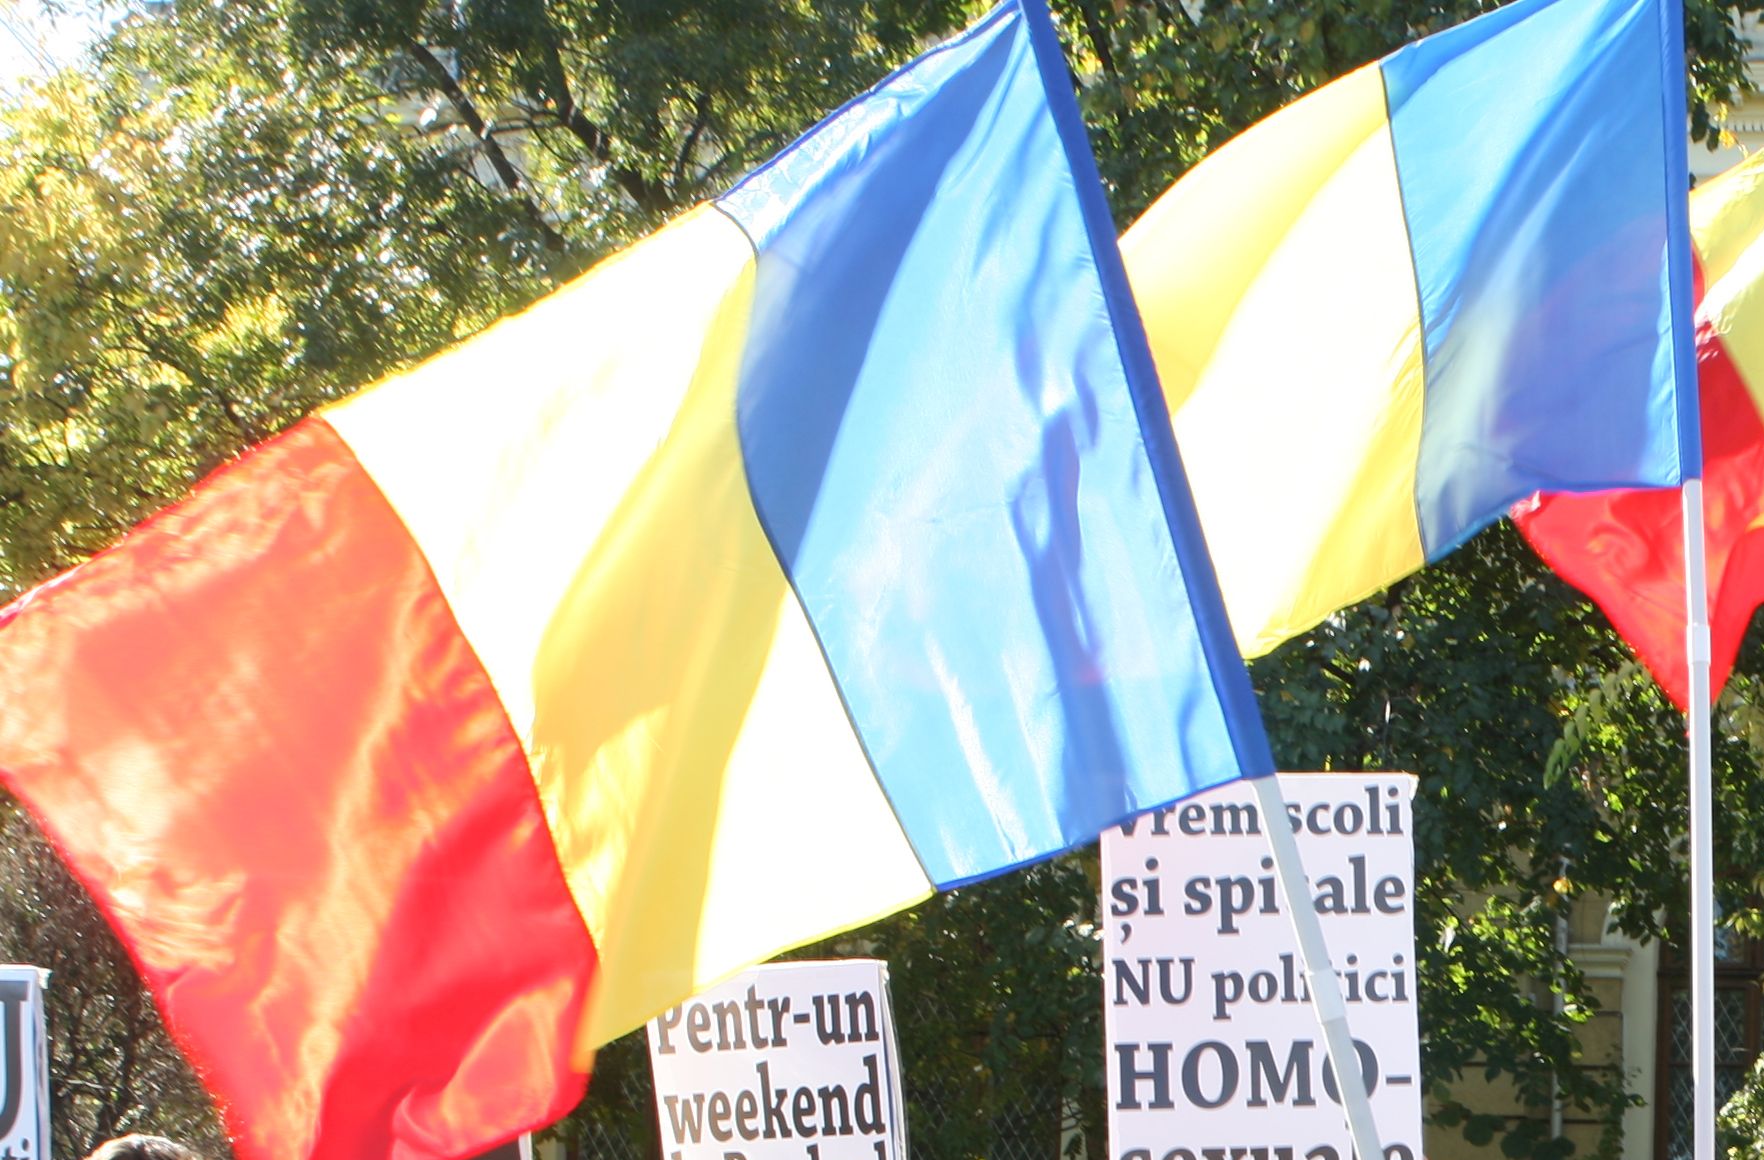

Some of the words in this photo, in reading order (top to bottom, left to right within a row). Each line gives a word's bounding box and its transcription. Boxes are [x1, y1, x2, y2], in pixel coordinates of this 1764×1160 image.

[1111, 857, 1164, 944] și
[1184, 854, 1406, 934] spiale
[656, 984, 880, 1055] Pentr-un
[1112, 957, 1195, 1006] NU
[1211, 952, 1410, 1020] polici
[664, 1053, 886, 1145] weekend
[1114, 1039, 1412, 1110] HOMO-
